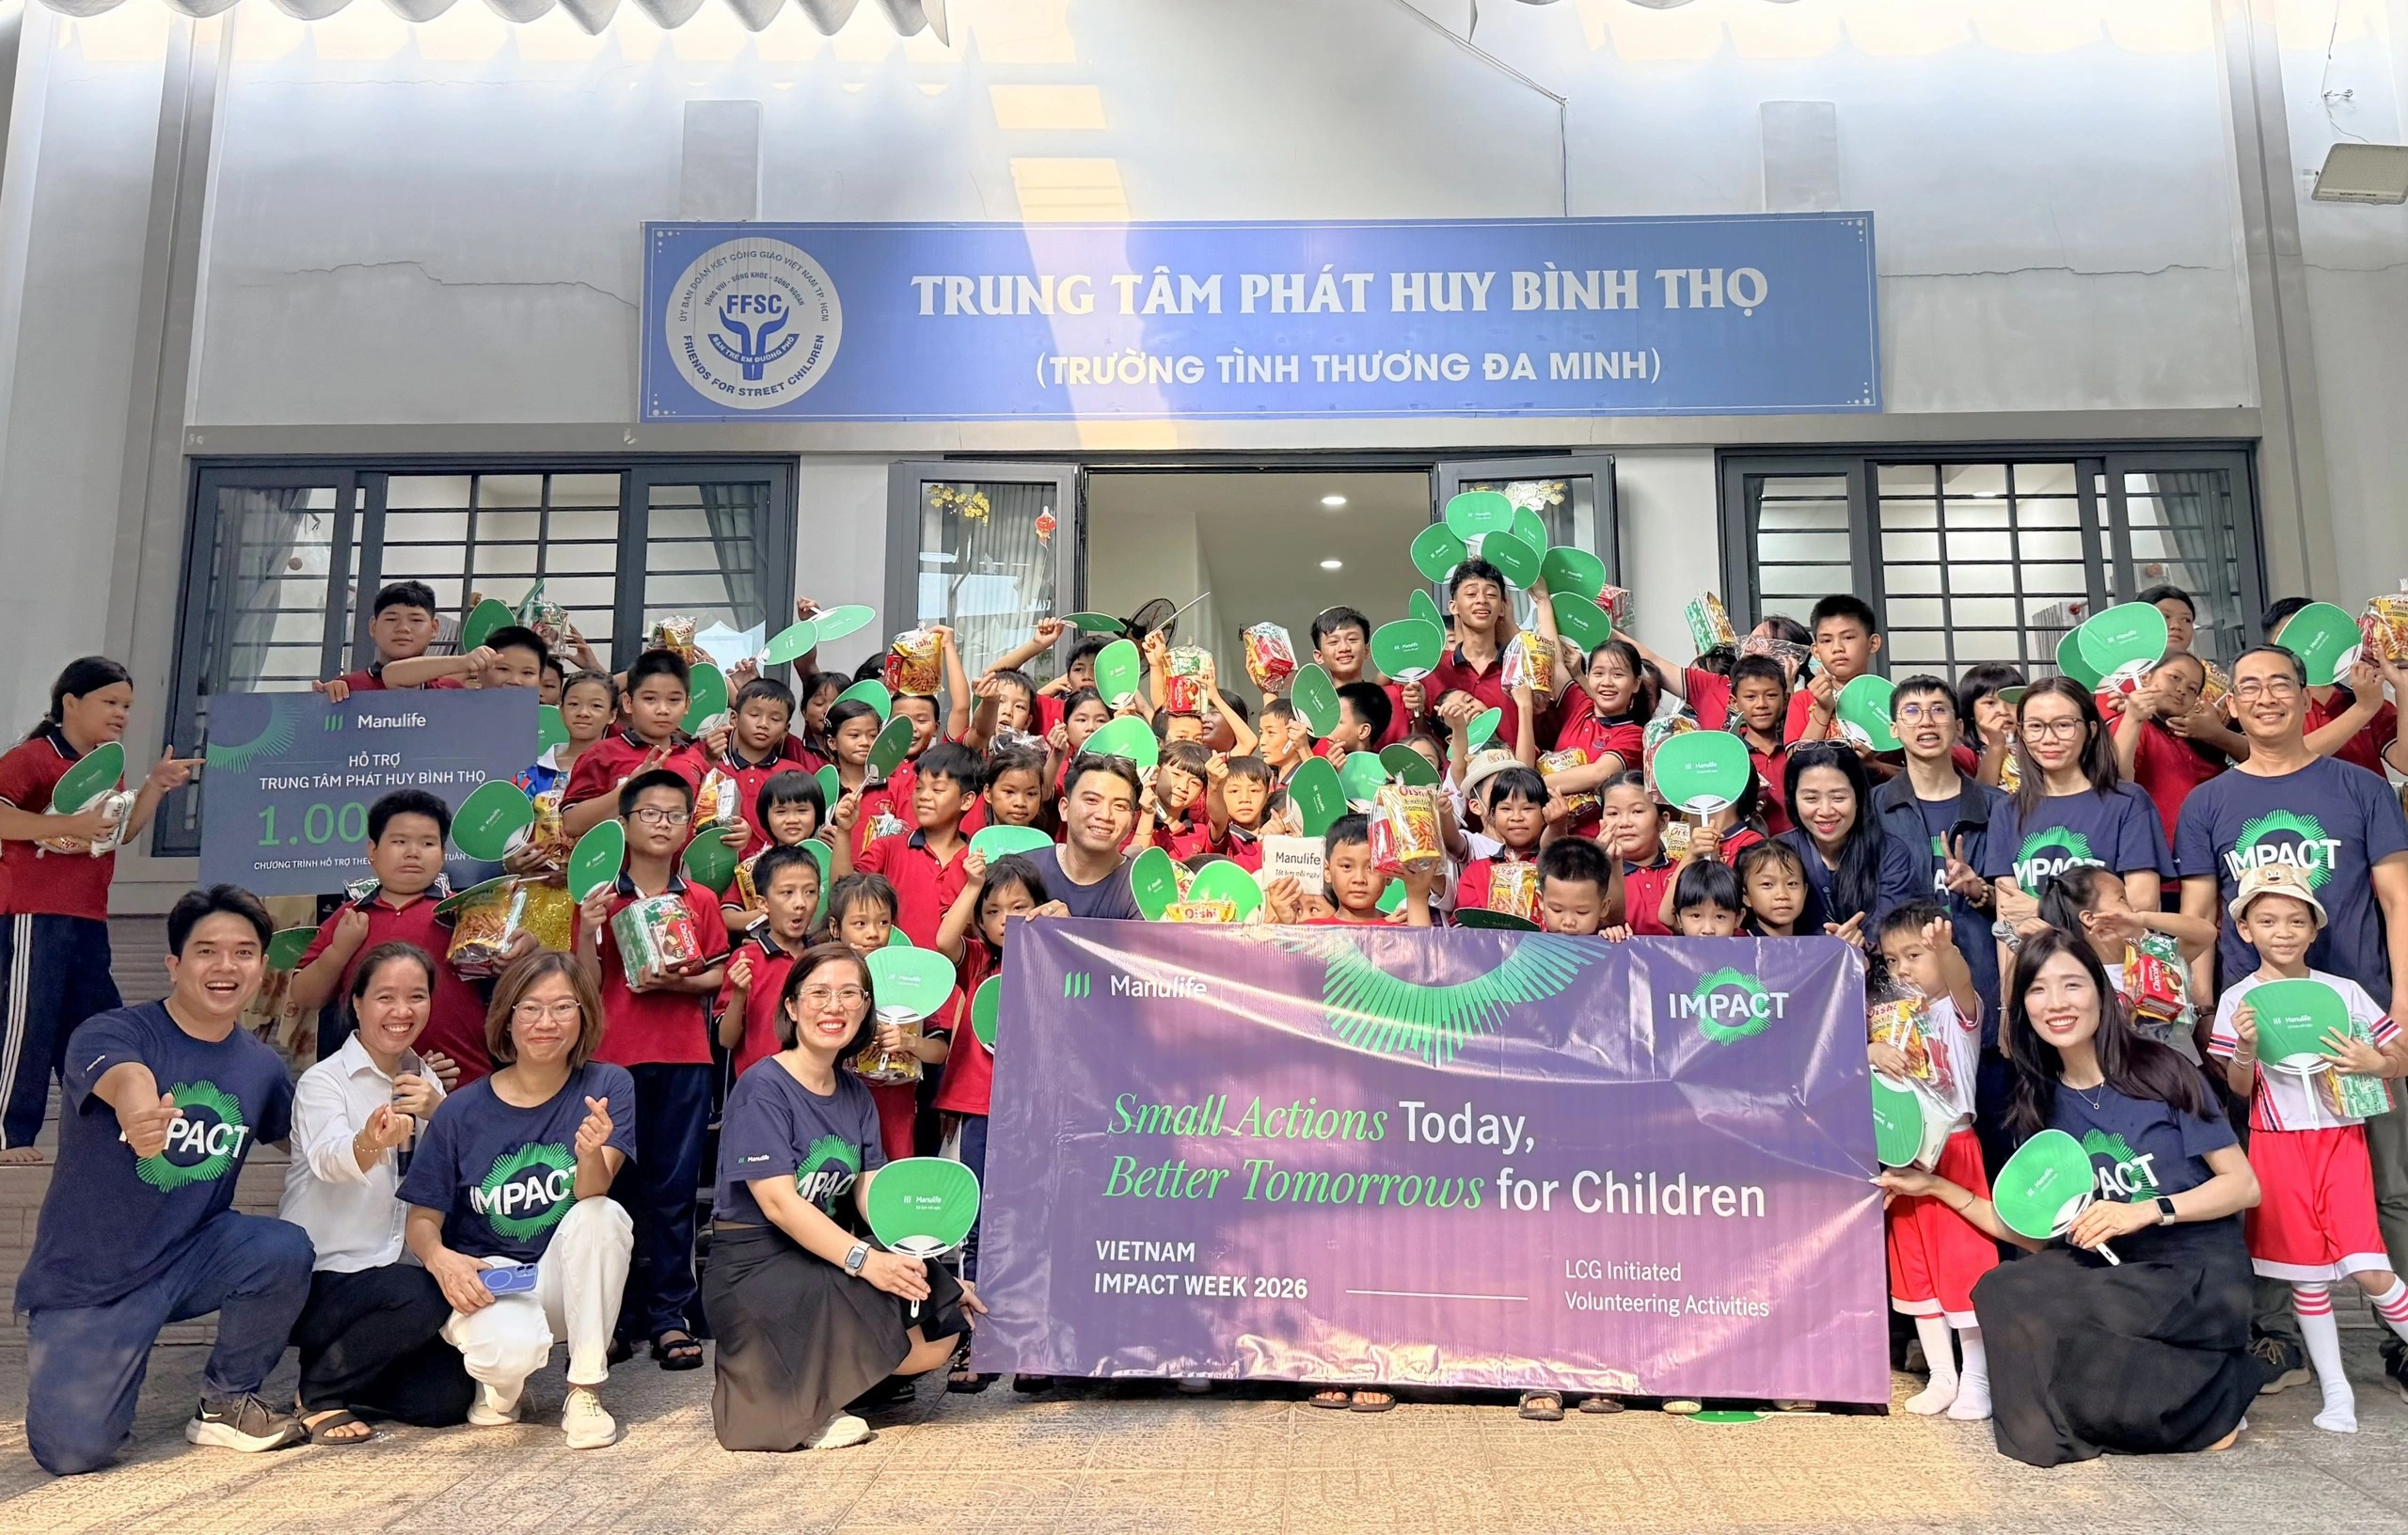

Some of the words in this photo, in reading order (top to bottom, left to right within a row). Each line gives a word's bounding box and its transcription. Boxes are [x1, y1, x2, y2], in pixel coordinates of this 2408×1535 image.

[682, 290, 694, 308] BAN
[800, 269, 818, 288] NAM
[820, 302, 829, 322] HCM
[726, 293, 783, 314] FFSC
[911, 274, 1095, 316] TRUNG
[1110, 265, 1223, 315] TÂM
[1240, 264, 1373, 314] PHÁT
[1390, 271, 1497, 313] HUY
[1512, 261, 1640, 311] BÌNH
[1655, 267, 1768, 317] THỌ
[683, 335, 712, 380] FRIENDS
[710, 377, 736, 394] FOR
[737, 382, 785, 397] STREET
[787, 335, 825, 385] CHILDREN
[1036, 348, 1206, 389] (TRƯỜNG
[1216, 347, 1299, 384] TÌNH
[1311, 350, 1470, 383] THƯƠNG
[1482, 352, 1537, 382] ĐA
[1550, 347, 1661, 385] MINH)
[357, 712, 427, 729] Manulife
[349, 751, 370, 768] HỖ
[372, 752, 402, 768] TRỢ
[260, 776, 309, 790] TRUNG
[312, 773, 342, 789] TÂM
[346, 771, 384, 787] PHÁT
[386, 772, 415, 786] HUY
[419, 769, 454, 784] BÌNH
[457, 769, 486, 784] THỌ
[258, 801, 370, 847] 1.00
[254, 859, 292, 870] CHƯƠNG
[293, 858, 318, 869] TRÌNH
[1275, 851, 1321, 865] Manulife
[2223, 838, 2341, 881] IMPACT
[1110, 974, 1208, 999] Manulife
[1669, 991, 1789, 1021] IMPACT
[119, 1117, 250, 1159] PACT
[1105, 1092, 1228, 1137] Small
[1231, 1095, 1388, 1143] Actions
[1399, 1100, 1536, 1155] Today,
[1102, 1154, 1230, 1200] Better
[1243, 1158, 1485, 1211] Tomorrows
[1497, 1167, 1560, 1212] for
[1571, 1168, 1766, 1218] Children
[2093, 1153, 2160, 1200] ACT
[1096, 1240, 1196, 1263] VIETNAM
[1564, 1258, 1602, 1280] LCG
[1607, 1260, 1682, 1282] Initiated
[1094, 1273, 1177, 1296] IMPACT
[1183, 1274, 1247, 1297] WEEK
[1254, 1276, 1308, 1299] 2026
[1564, 1290, 1681, 1317] Volunteering
[1684, 1293, 1770, 1318] Activities
